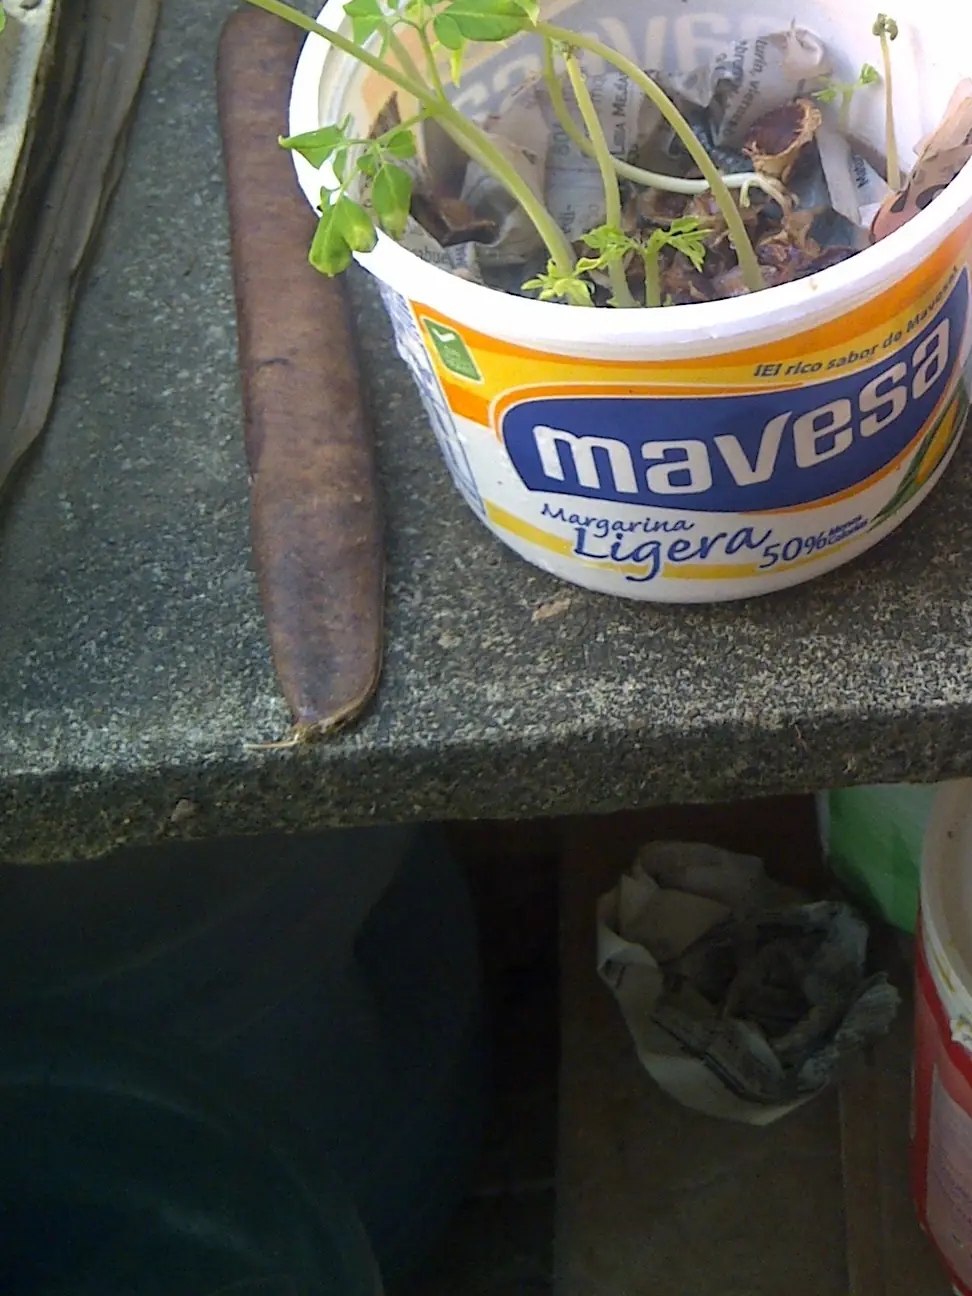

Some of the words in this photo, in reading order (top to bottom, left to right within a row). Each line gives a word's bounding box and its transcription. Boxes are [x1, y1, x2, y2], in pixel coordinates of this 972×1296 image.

[785, 360, 822, 375] rico
[826, 344, 880, 371] sabor
[882, 330, 903, 350] de
[533, 316, 953, 495] mavesa
[540, 503, 696, 538] Margarina
[574, 524, 772, 581] Ligera
[759, 531, 827, 568] 50%
